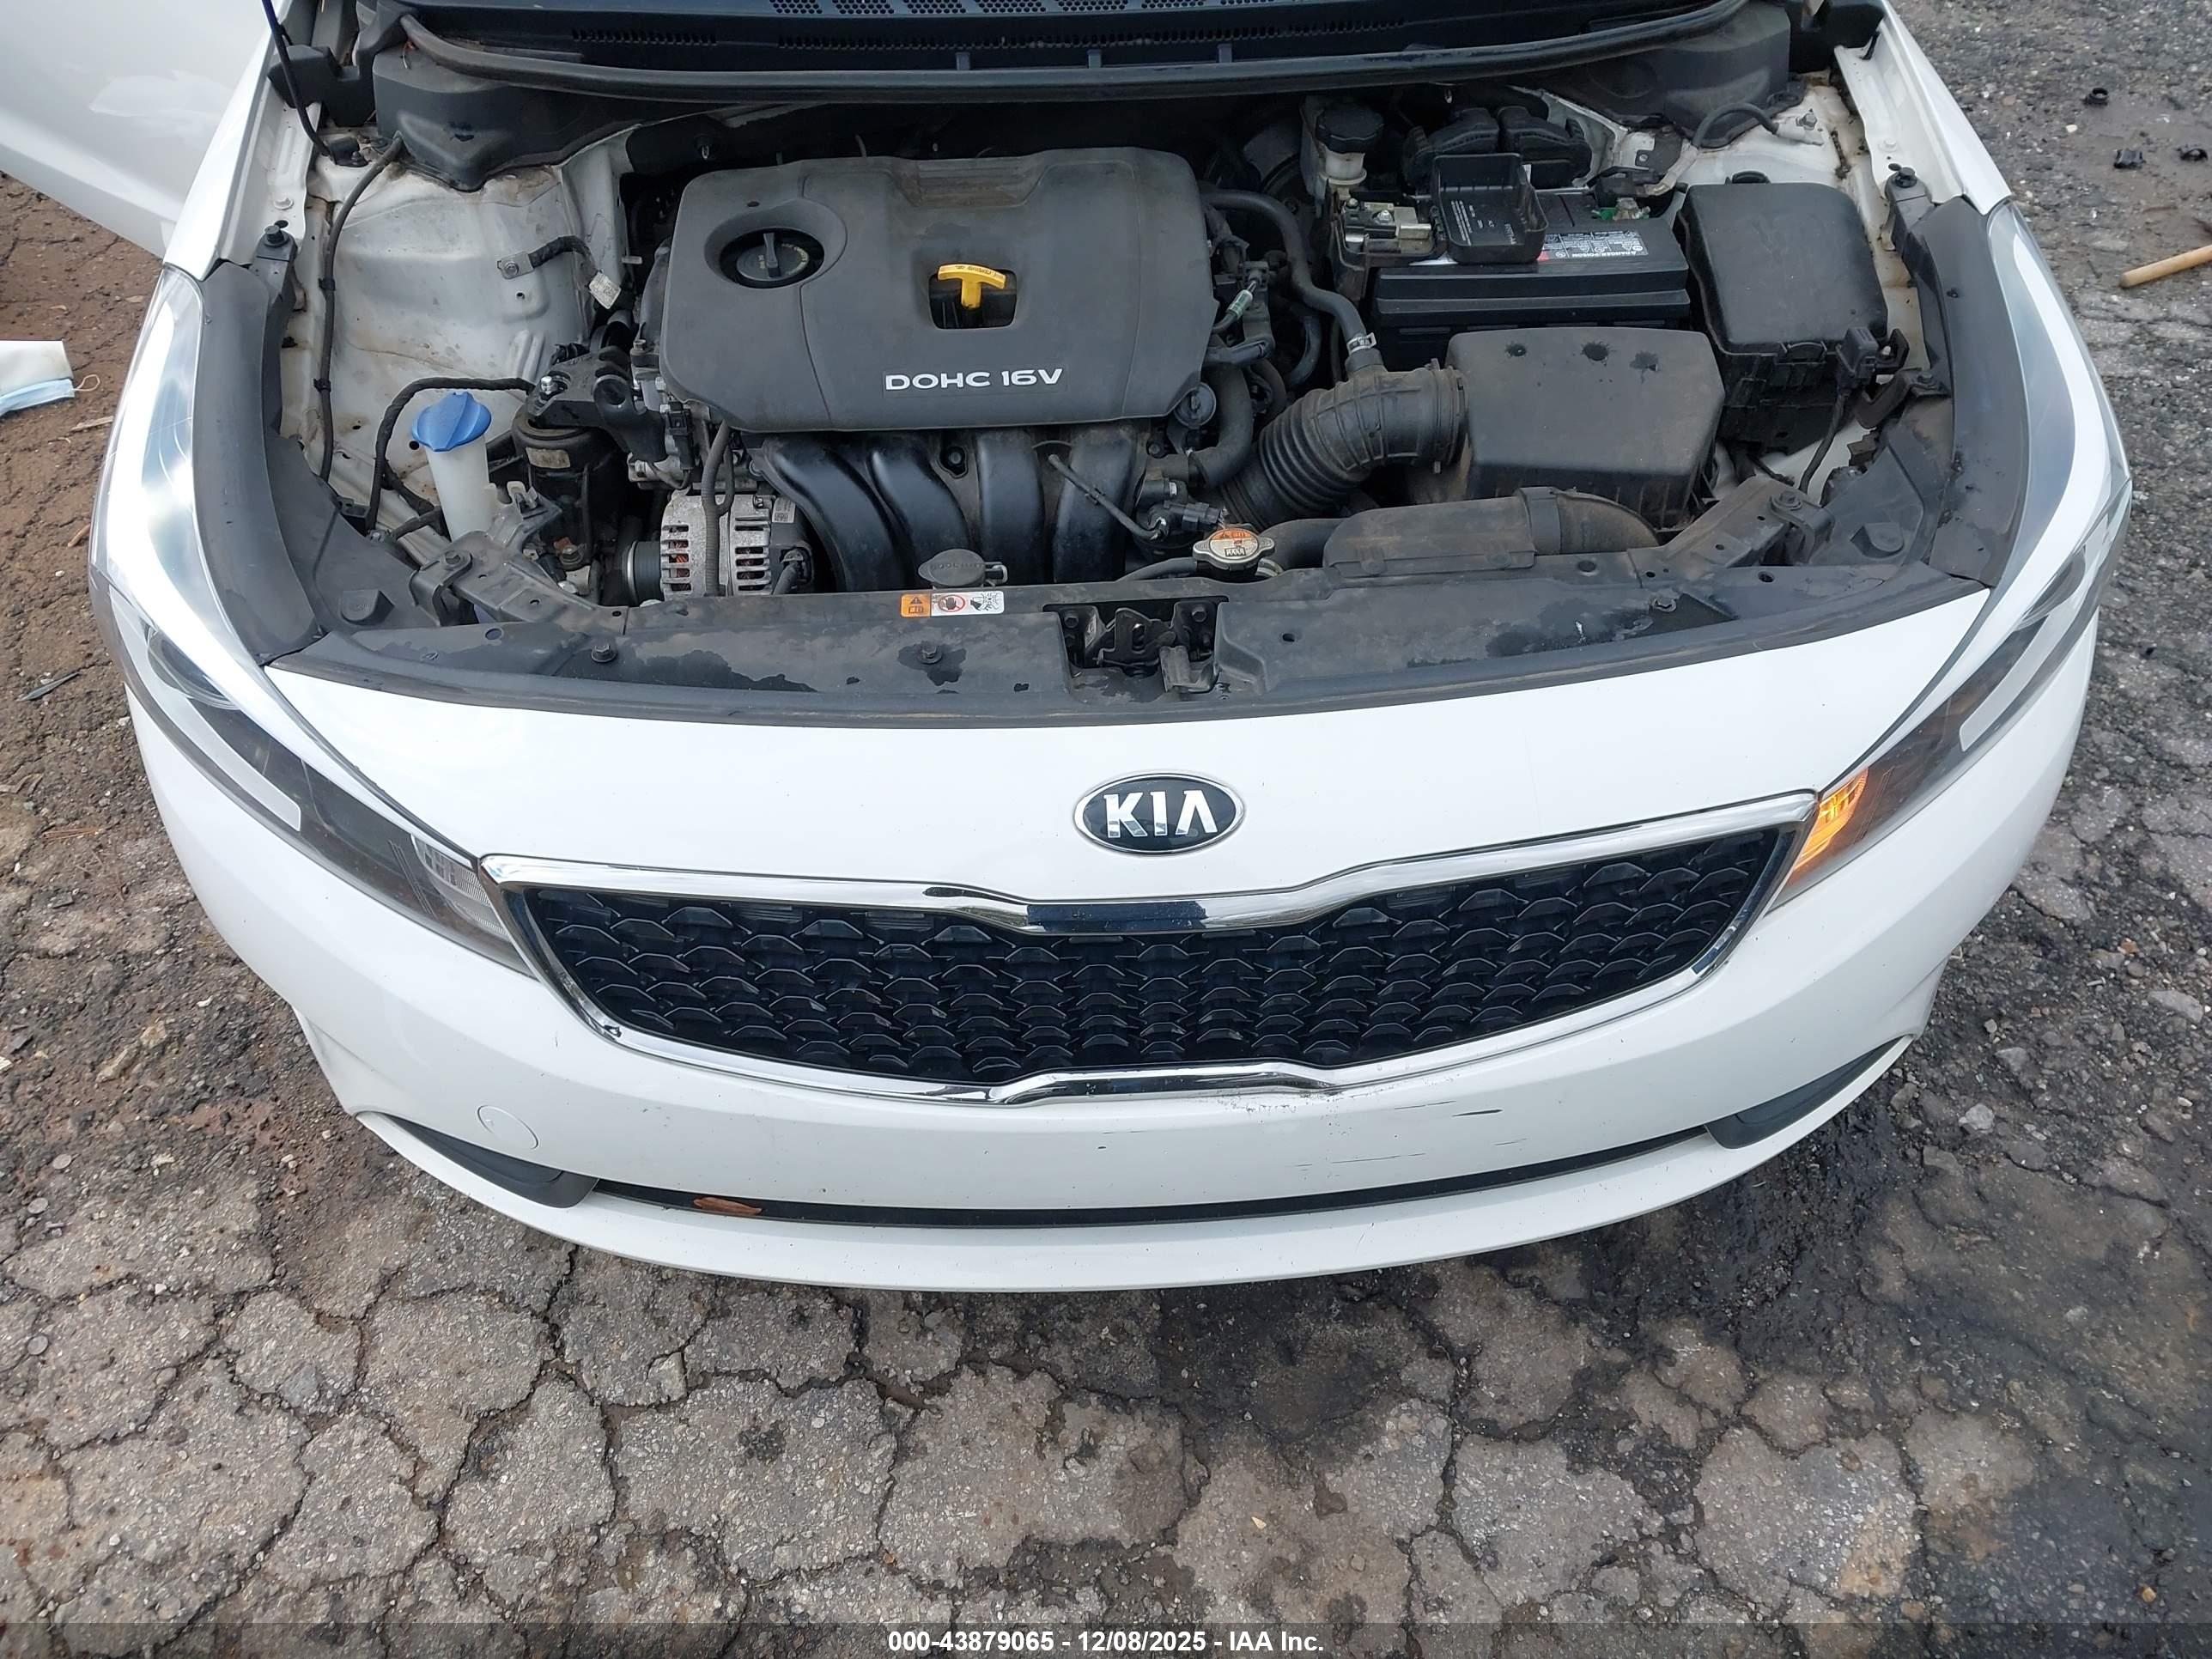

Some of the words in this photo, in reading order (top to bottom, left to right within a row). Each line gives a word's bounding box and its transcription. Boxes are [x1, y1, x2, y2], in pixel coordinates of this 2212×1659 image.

[885, 371, 991, 391] DOHC
[1001, 368, 1063, 386] 16V
[1103, 789, 1218, 838] KIA
